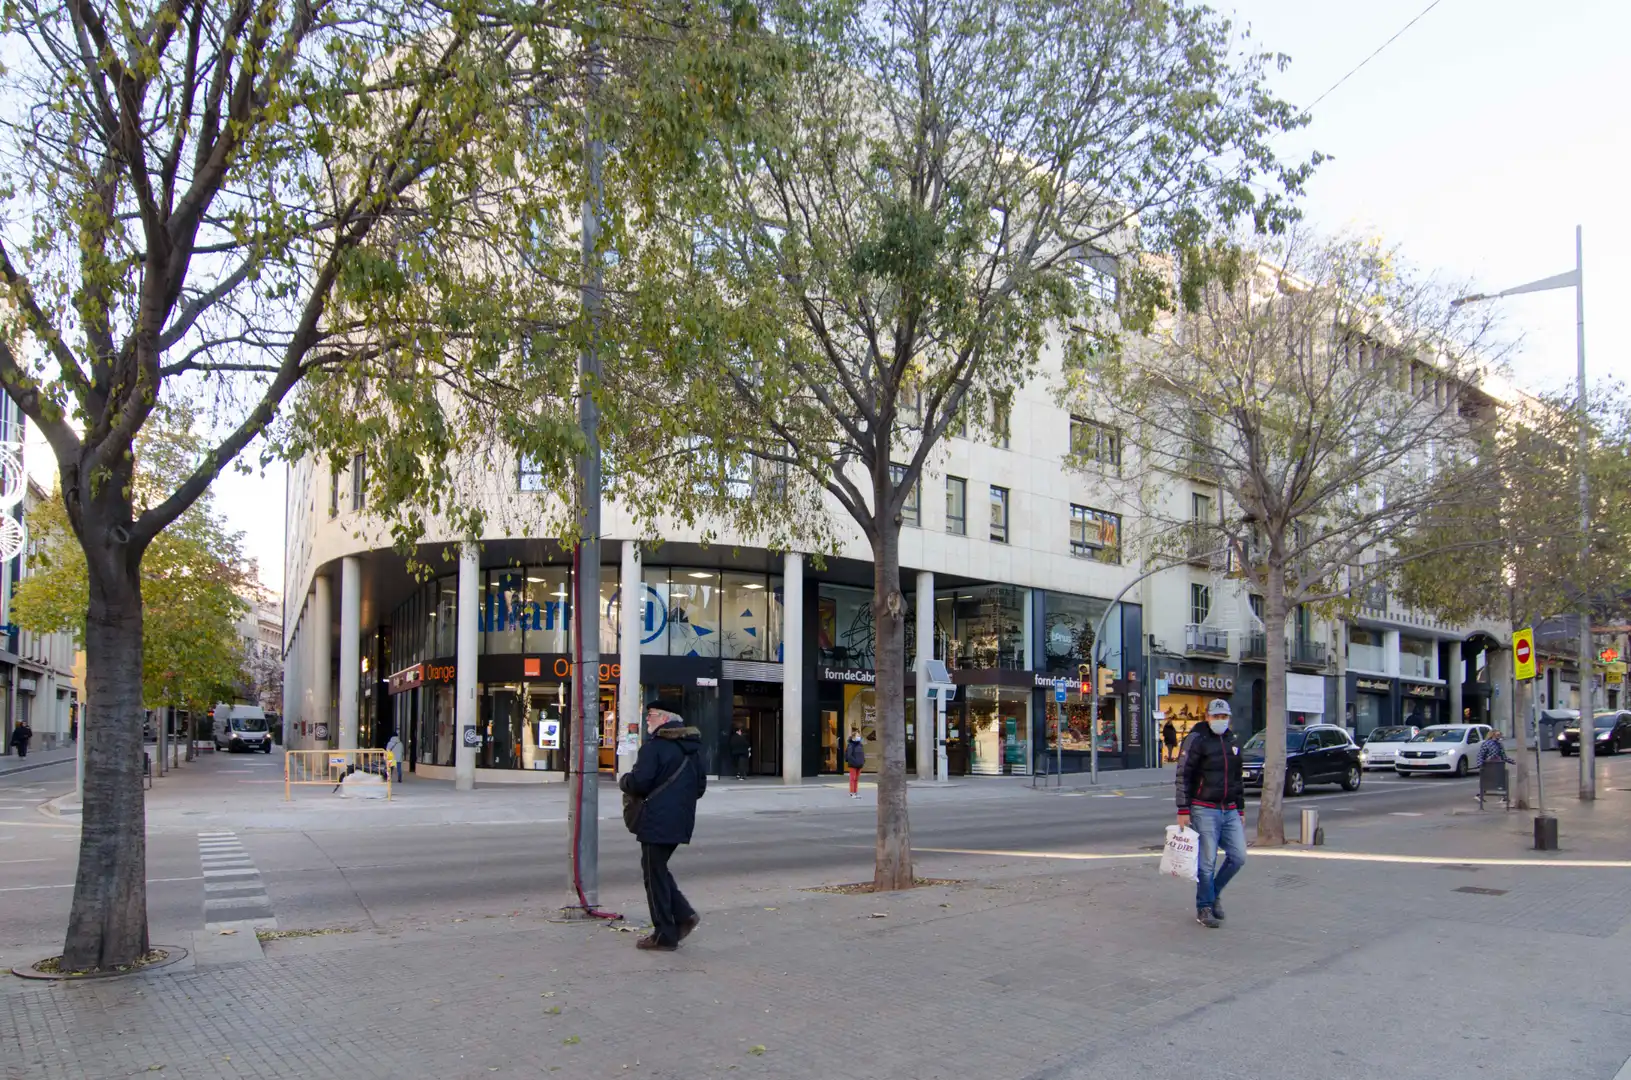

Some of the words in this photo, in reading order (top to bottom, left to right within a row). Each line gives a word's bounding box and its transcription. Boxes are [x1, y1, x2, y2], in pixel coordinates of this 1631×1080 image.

[427, 664, 455, 682] Orange
[554, 658, 621, 680] Orge
[824, 667, 876, 682] forndeCabr
[1163, 671, 1194, 687] MON
[1199, 675, 1233, 690] GROC
